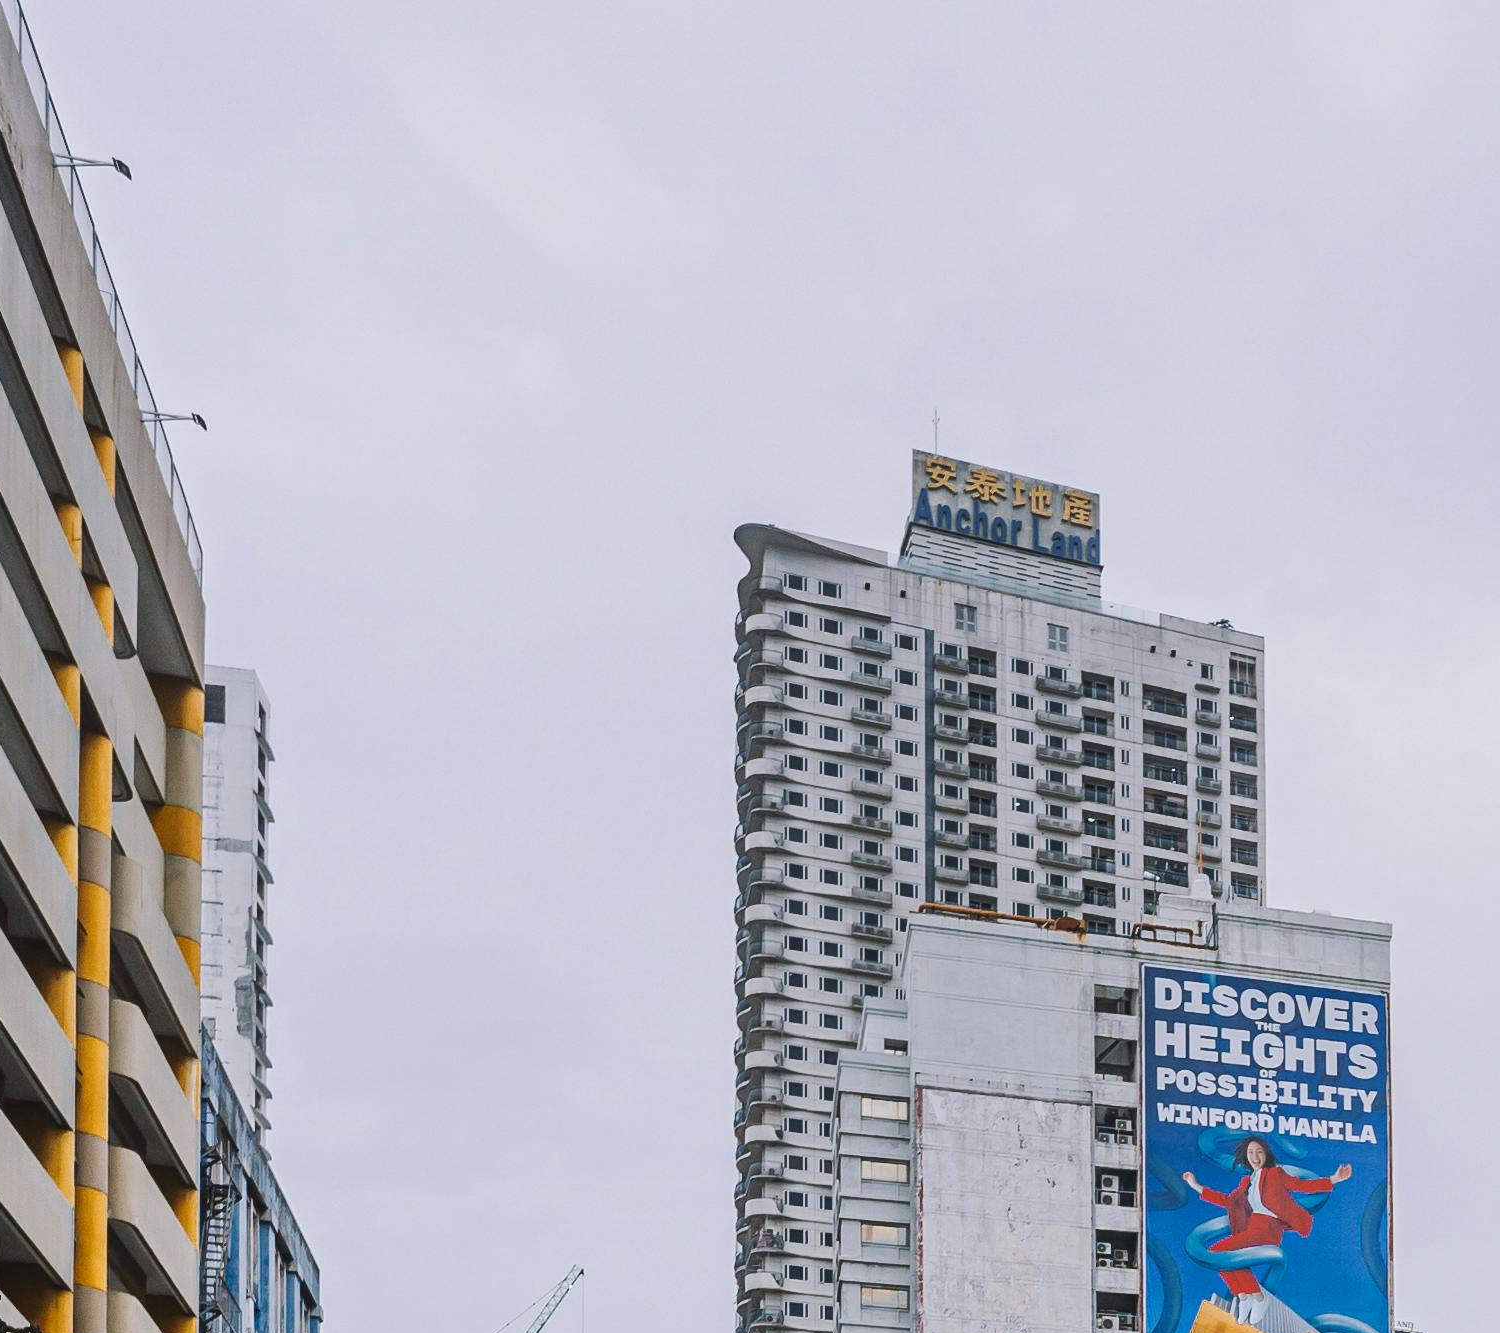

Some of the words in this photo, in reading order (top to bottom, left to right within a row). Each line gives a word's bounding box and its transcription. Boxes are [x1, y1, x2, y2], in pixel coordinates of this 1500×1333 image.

[925, 456, 1093, 529] 安泰地產
[914, 488, 1022, 547] Anchor
[1032, 517, 1100, 564] Land
[1154, 977, 1379, 1035] DISCOVER
[1255, 1021, 1281, 1033] THE
[1154, 1020, 1378, 1080] HEIGHTS
[1156, 1066, 1378, 1113] POSSIBILITY
[1259, 1069, 1277, 1079] OF
[1156, 1102, 1275, 1133] WINFORD
[1278, 1115, 1378, 1144] MANILA
[1260, 1103, 1278, 1114] AT
